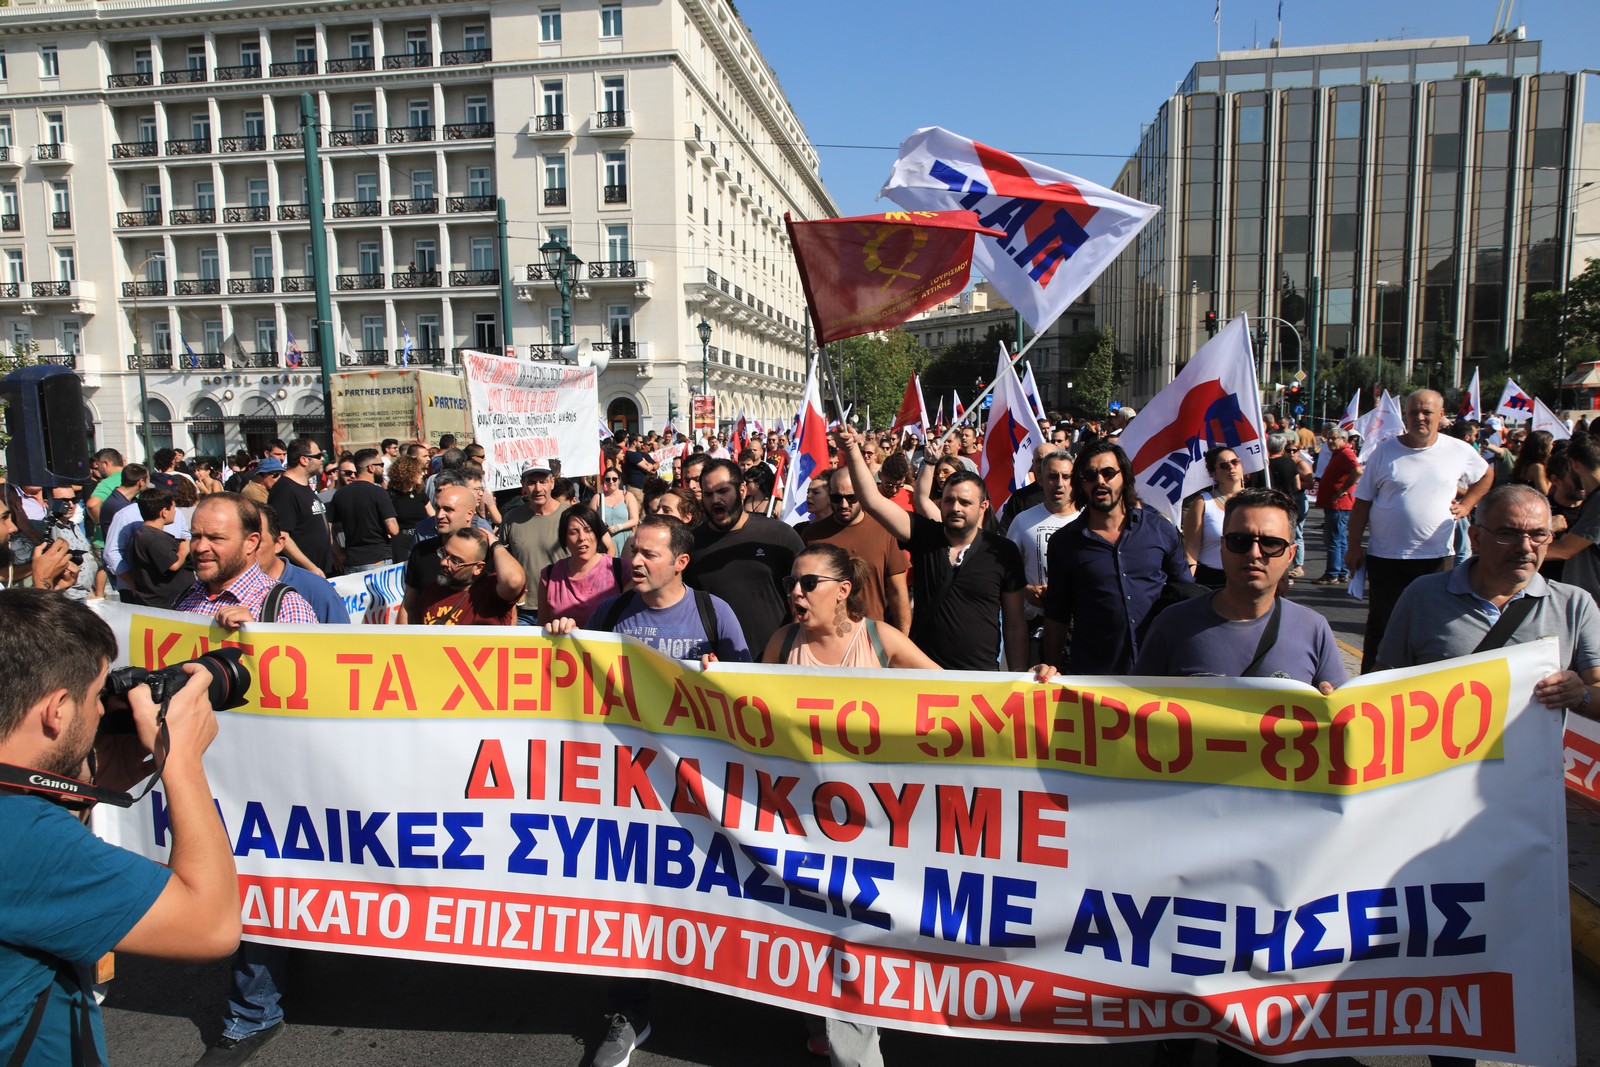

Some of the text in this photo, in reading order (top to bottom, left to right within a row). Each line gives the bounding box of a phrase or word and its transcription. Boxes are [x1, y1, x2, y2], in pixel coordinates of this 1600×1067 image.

[921, 279, 952, 299] ΑΤΤΙΚΗΣ
[202, 376, 251, 387] HOTEL
[345, 386, 414, 397] PARTNER EXPRESS
[434, 396, 468, 410] PARTNER
[645, 626, 658, 636] THE
[144, 628, 308, 710] ΚΩ
[336, 653, 418, 711] ΤΑ
[441, 646, 641, 722] ΧΕΡΙΑ
[663, 677, 776, 748] ΑΠΟ
[796, 697, 881, 756] ΤΟ
[29, 774, 78, 793] Canon
[464, 739, 1069, 868] ΔΙΕΚΔΙΚΟΥΜΕ
[152, 790, 1486, 976] ΚΑΔΙΚΕΣ ΣΥΜΒΑΣΕΙΣ ΜΕ ΑΥΞΗΣΕΙΣ
[425, 896, 727, 970] ΕΠΙΣΙΤΙΣΜΟΥ
[740, 929, 1034, 1023] ΤΟΥΡΙΣΜΟΥ
[1052, 984, 1482, 1046] ΞΕΝΟΔΟΧΕΙΩΝ
